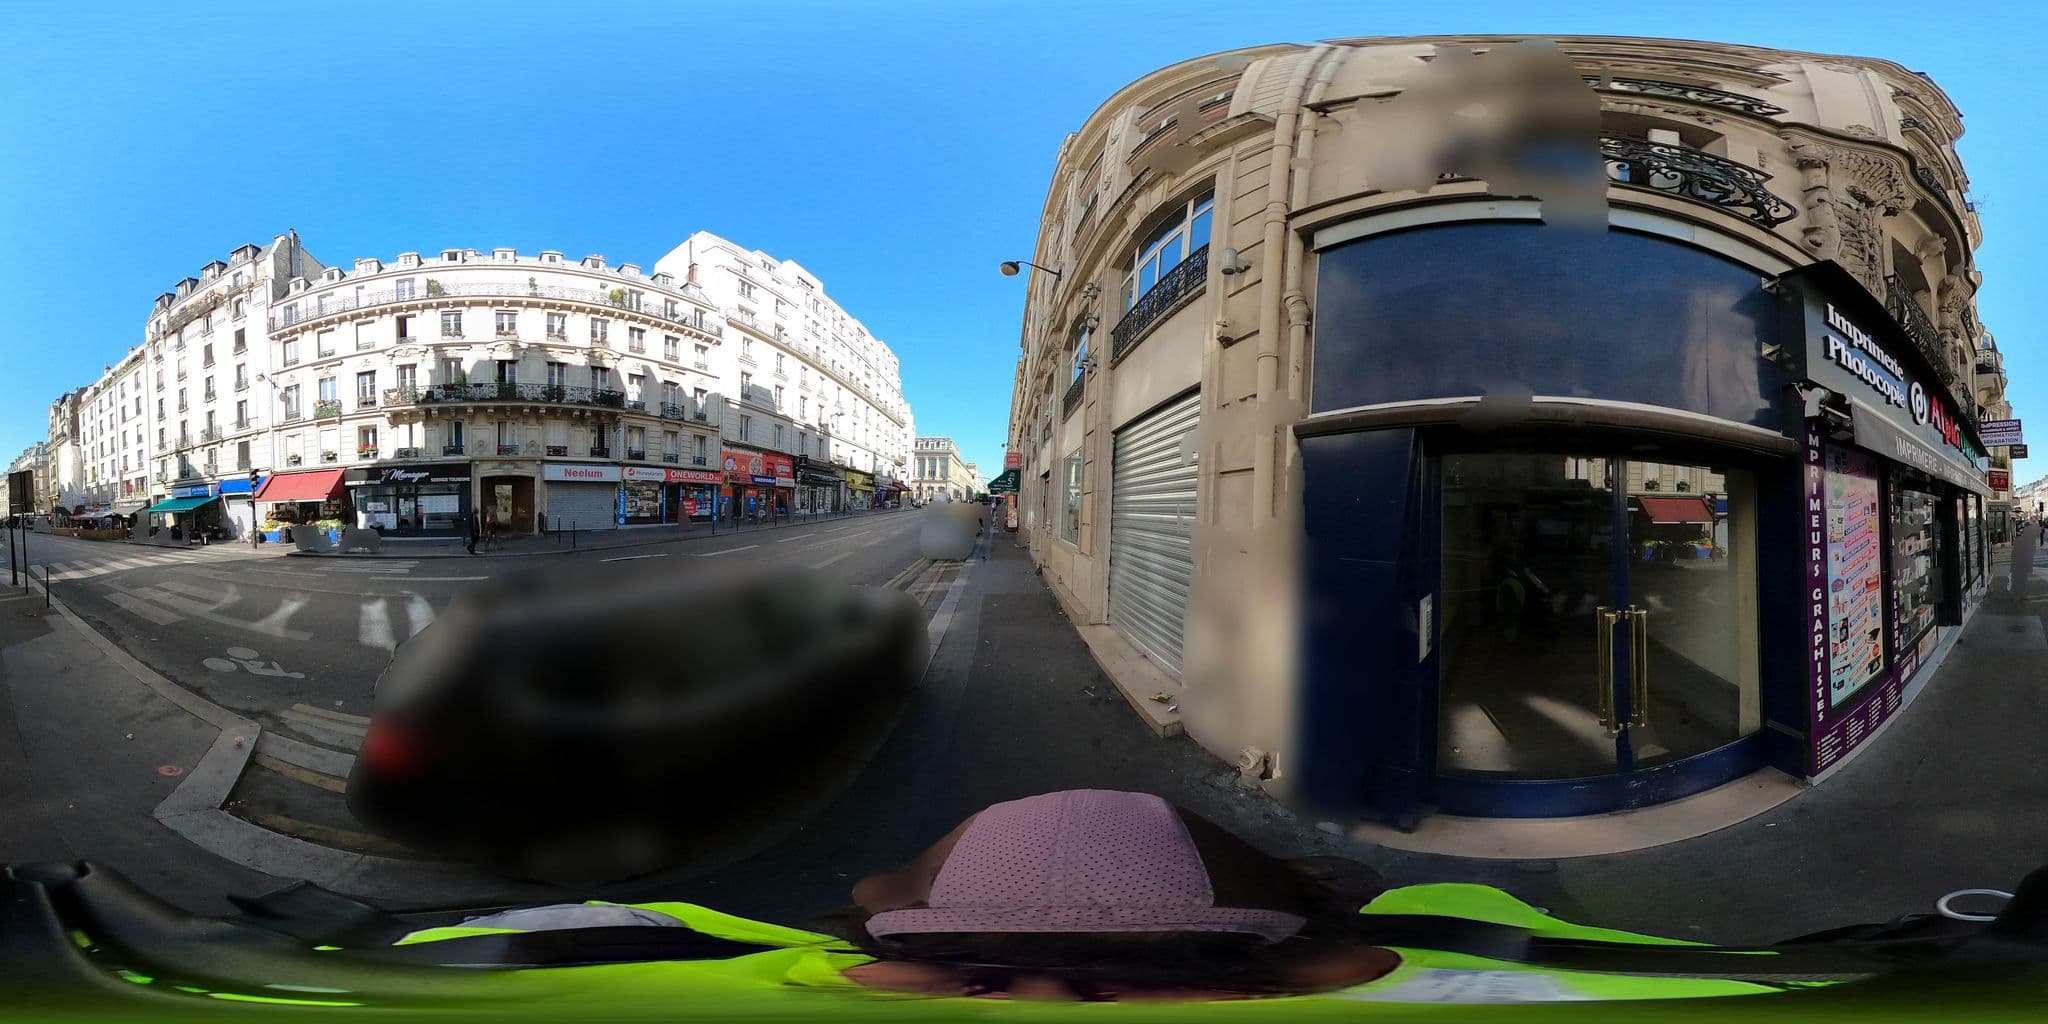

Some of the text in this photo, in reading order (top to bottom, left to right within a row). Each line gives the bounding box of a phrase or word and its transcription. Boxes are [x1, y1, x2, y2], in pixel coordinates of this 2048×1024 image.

[1827, 303, 1904, 382] Imprimerie
[1828, 334, 1906, 409] Photocopie
[1981, 421, 2019, 429] IMPRESSION
[1895, 436, 1938, 472] IMPRIMERIE
[389, 468, 430, 483] Manager
[564, 468, 603, 478] Neelum
[671, 470, 714, 481] ONEWORLD
[1812, 588, 1824, 722] GRAPHISTES
